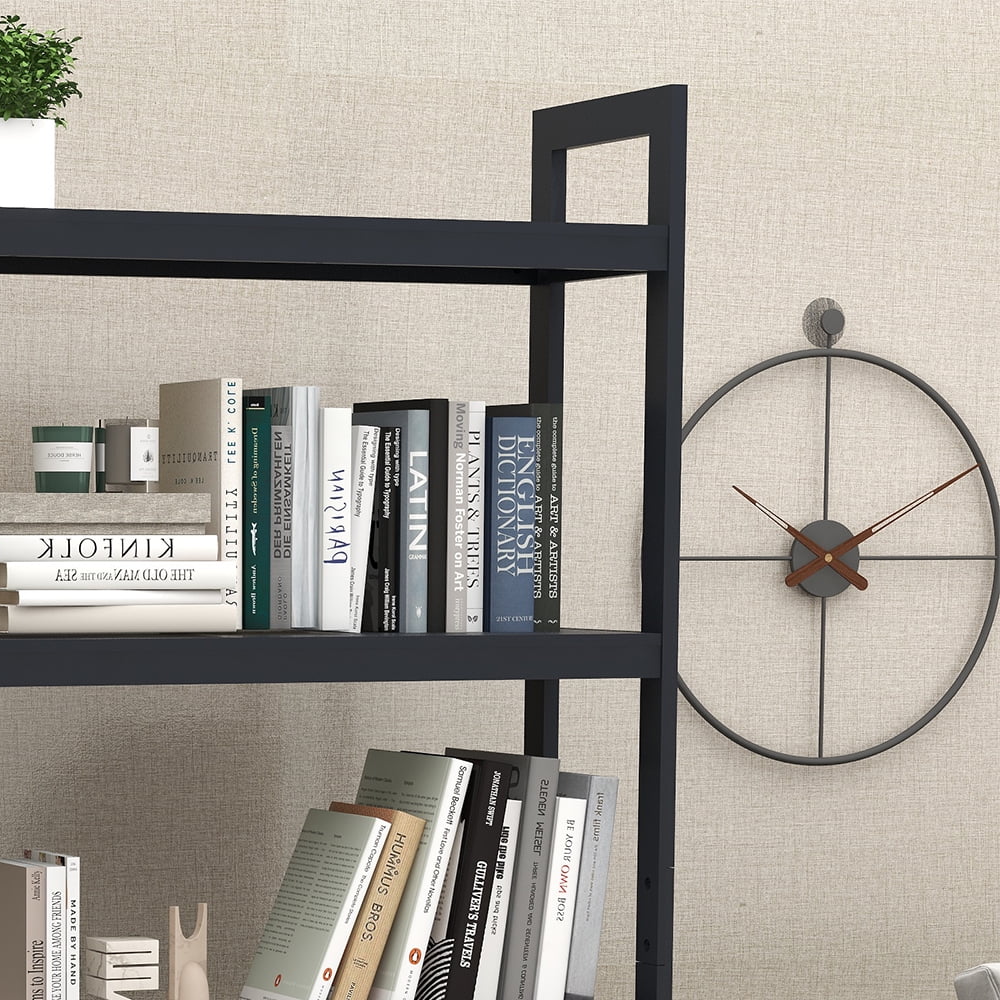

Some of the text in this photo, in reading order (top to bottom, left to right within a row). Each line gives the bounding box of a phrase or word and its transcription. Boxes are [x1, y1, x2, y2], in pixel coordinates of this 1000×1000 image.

[360, 442, 368, 464] Essential
[370, 428, 380, 458] Designing
[393, 428, 401, 458] Designing
[354, 488, 364, 518] Typography
[382, 489, 391, 519] Typography
[408, 451, 428, 552] LATIN
[452, 403, 466, 592] Moving Norman Foster on Art
[467, 430, 481, 589] PLANTS & TREES
[496, 435, 517, 576] DICTIONARY
[516, 435, 535, 576] ENGLISH
[534, 495, 542, 523] ART
[549, 494, 559, 524] ART
[534, 526, 542, 537] &
[549, 526, 558, 537] &
[533, 542, 542, 599] ARTISTS
[548, 540, 559, 599] ARTISTS
[446, 765, 468, 825] Samuel Beckett
[485, 770, 502, 827] JONATHAN SWIFT
[364, 824, 386, 873] Truman Capote
[439, 839, 447, 855] Love
[376, 832, 406, 896] HUMMUS
[431, 869, 440, 887] Other
[31, 871, 42, 901] Annie Kelly
[351, 881, 365, 906] Complete
[52, 891, 62, 921] FRIENDS
[459, 860, 488, 968] GULLIVER'S TRAVELS
[52, 922, 62, 949] AMONG
[360, 903, 383, 944] BROS.
[27, 940, 46, 973] Inspire
[70, 935, 77, 949] BY
[52, 950, 62, 972] HOME
[30, 976, 44, 986] to
[52, 973, 62, 992] YOUR
